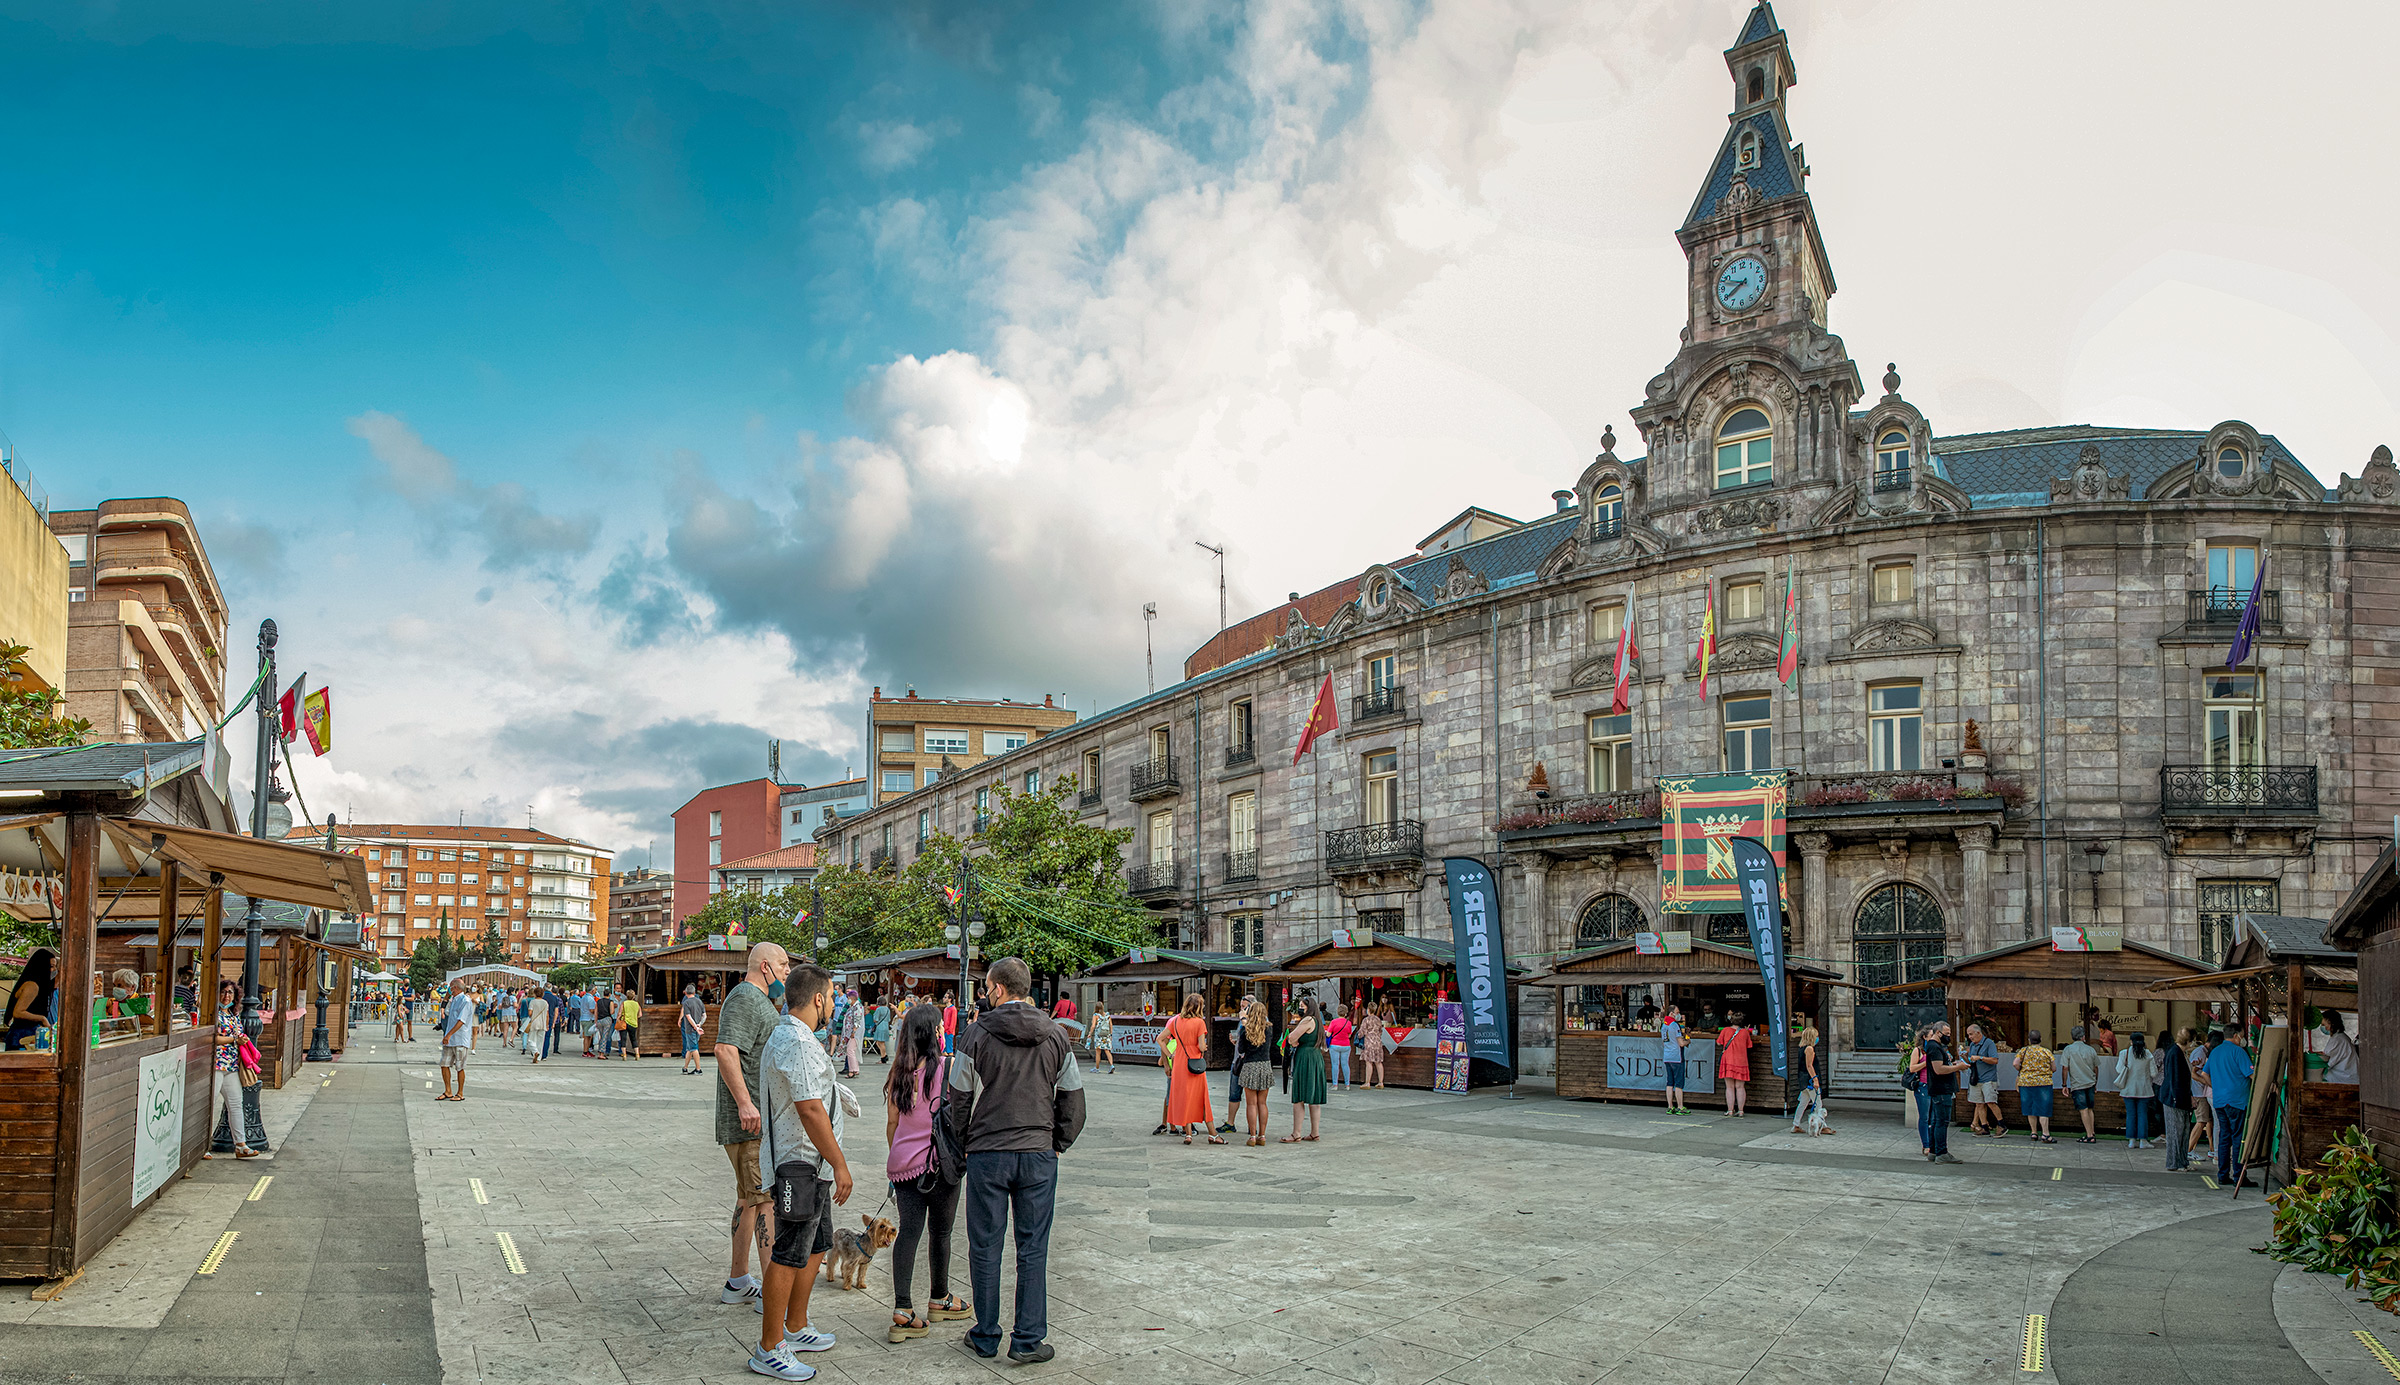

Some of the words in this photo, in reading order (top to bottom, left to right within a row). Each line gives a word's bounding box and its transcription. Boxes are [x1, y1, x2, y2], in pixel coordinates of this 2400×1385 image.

[1739, 261, 1746, 269] 12
[1731, 266, 1736, 274] 11
[1756, 285, 1760, 293] 4
[2106, 1015, 2140, 1025] Blanco
[1118, 1033, 1158, 1047] TRESV
[1615, 1056, 1708, 1080] SIDEIT
